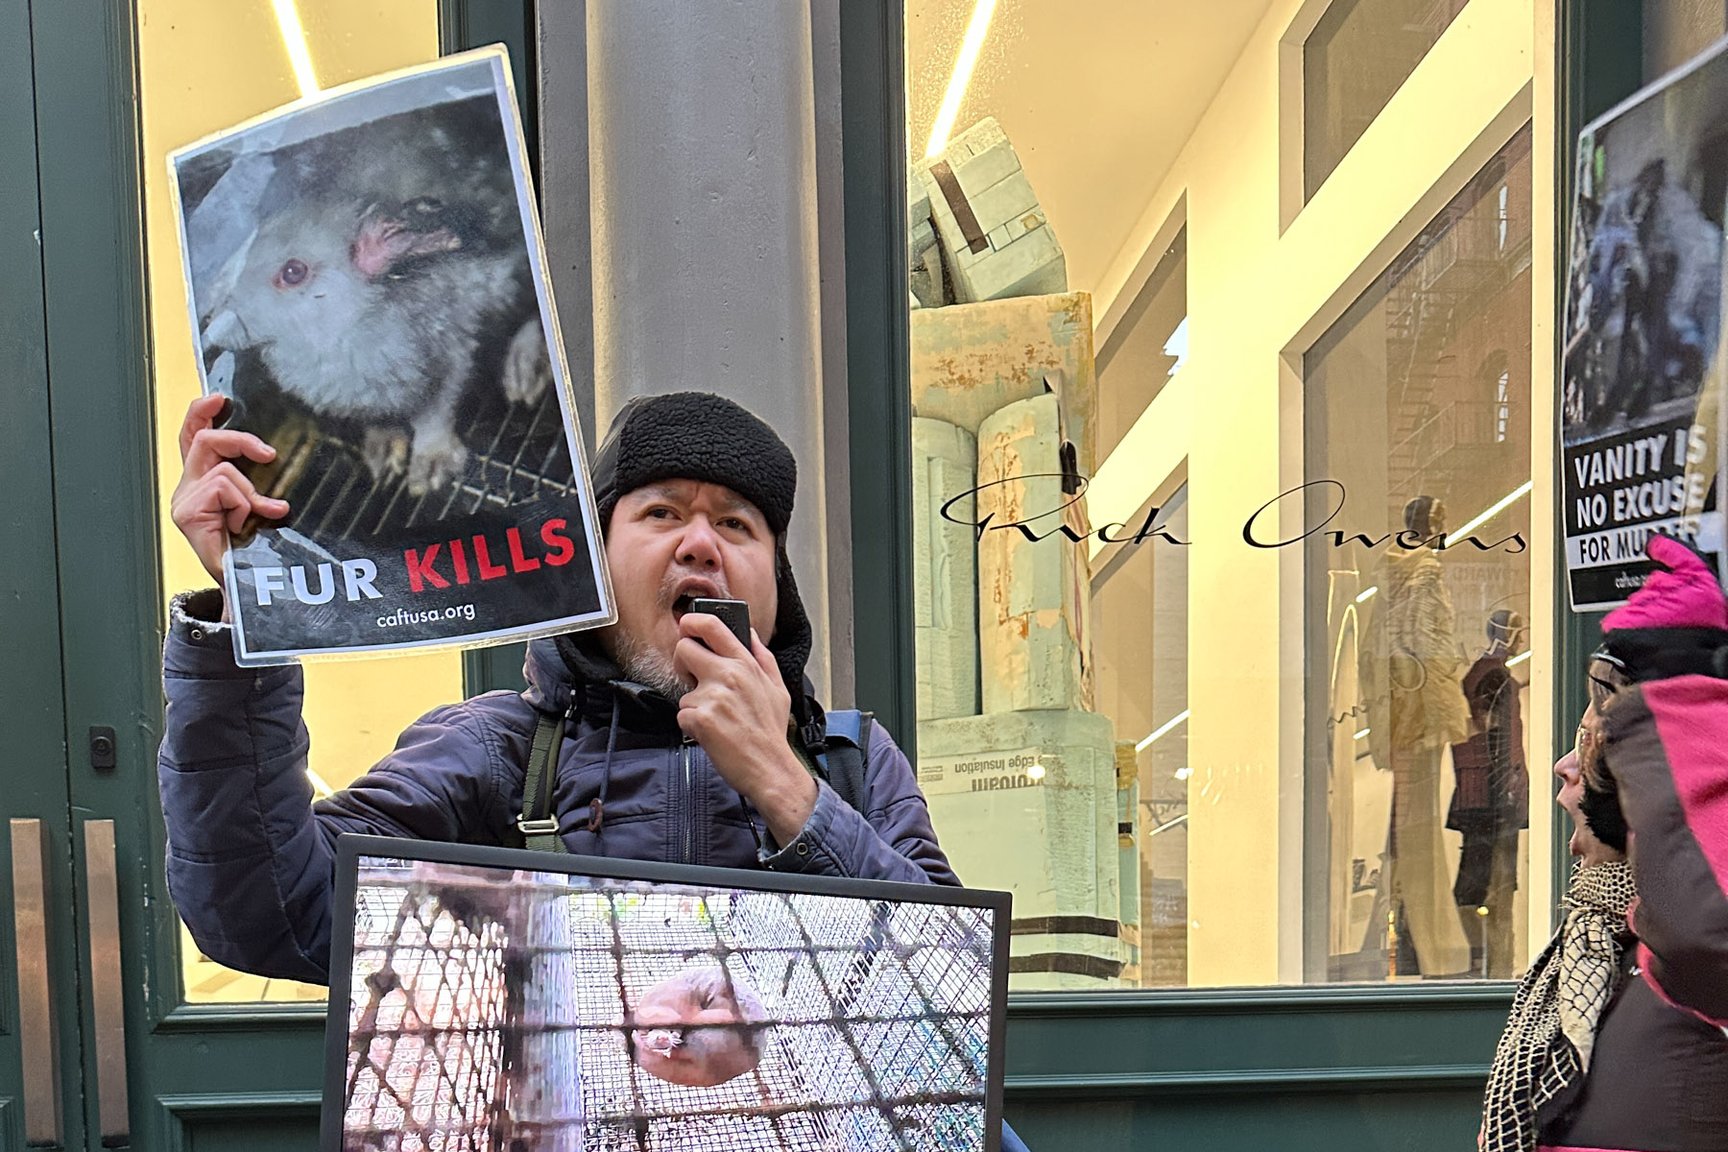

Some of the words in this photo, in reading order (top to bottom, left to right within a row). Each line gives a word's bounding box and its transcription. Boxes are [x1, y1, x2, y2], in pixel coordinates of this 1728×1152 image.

[1574, 433, 1669, 489] VANITY
[1673, 424, 1708, 467] IS
[940, 473, 1192, 545] Rick
[1243, 479, 1528, 555] Owens
[1576, 493, 1608, 530] NO
[1613, 471, 1705, 522] EXCUSE
[252, 558, 384, 606] FUR
[404, 518, 576, 593] KILLS
[1578, 535, 1611, 564] FOR
[376, 601, 476, 629] caftusa.org
[954, 759, 1005, 774] Insulation
[1008, 755, 1035, 768] Edge
